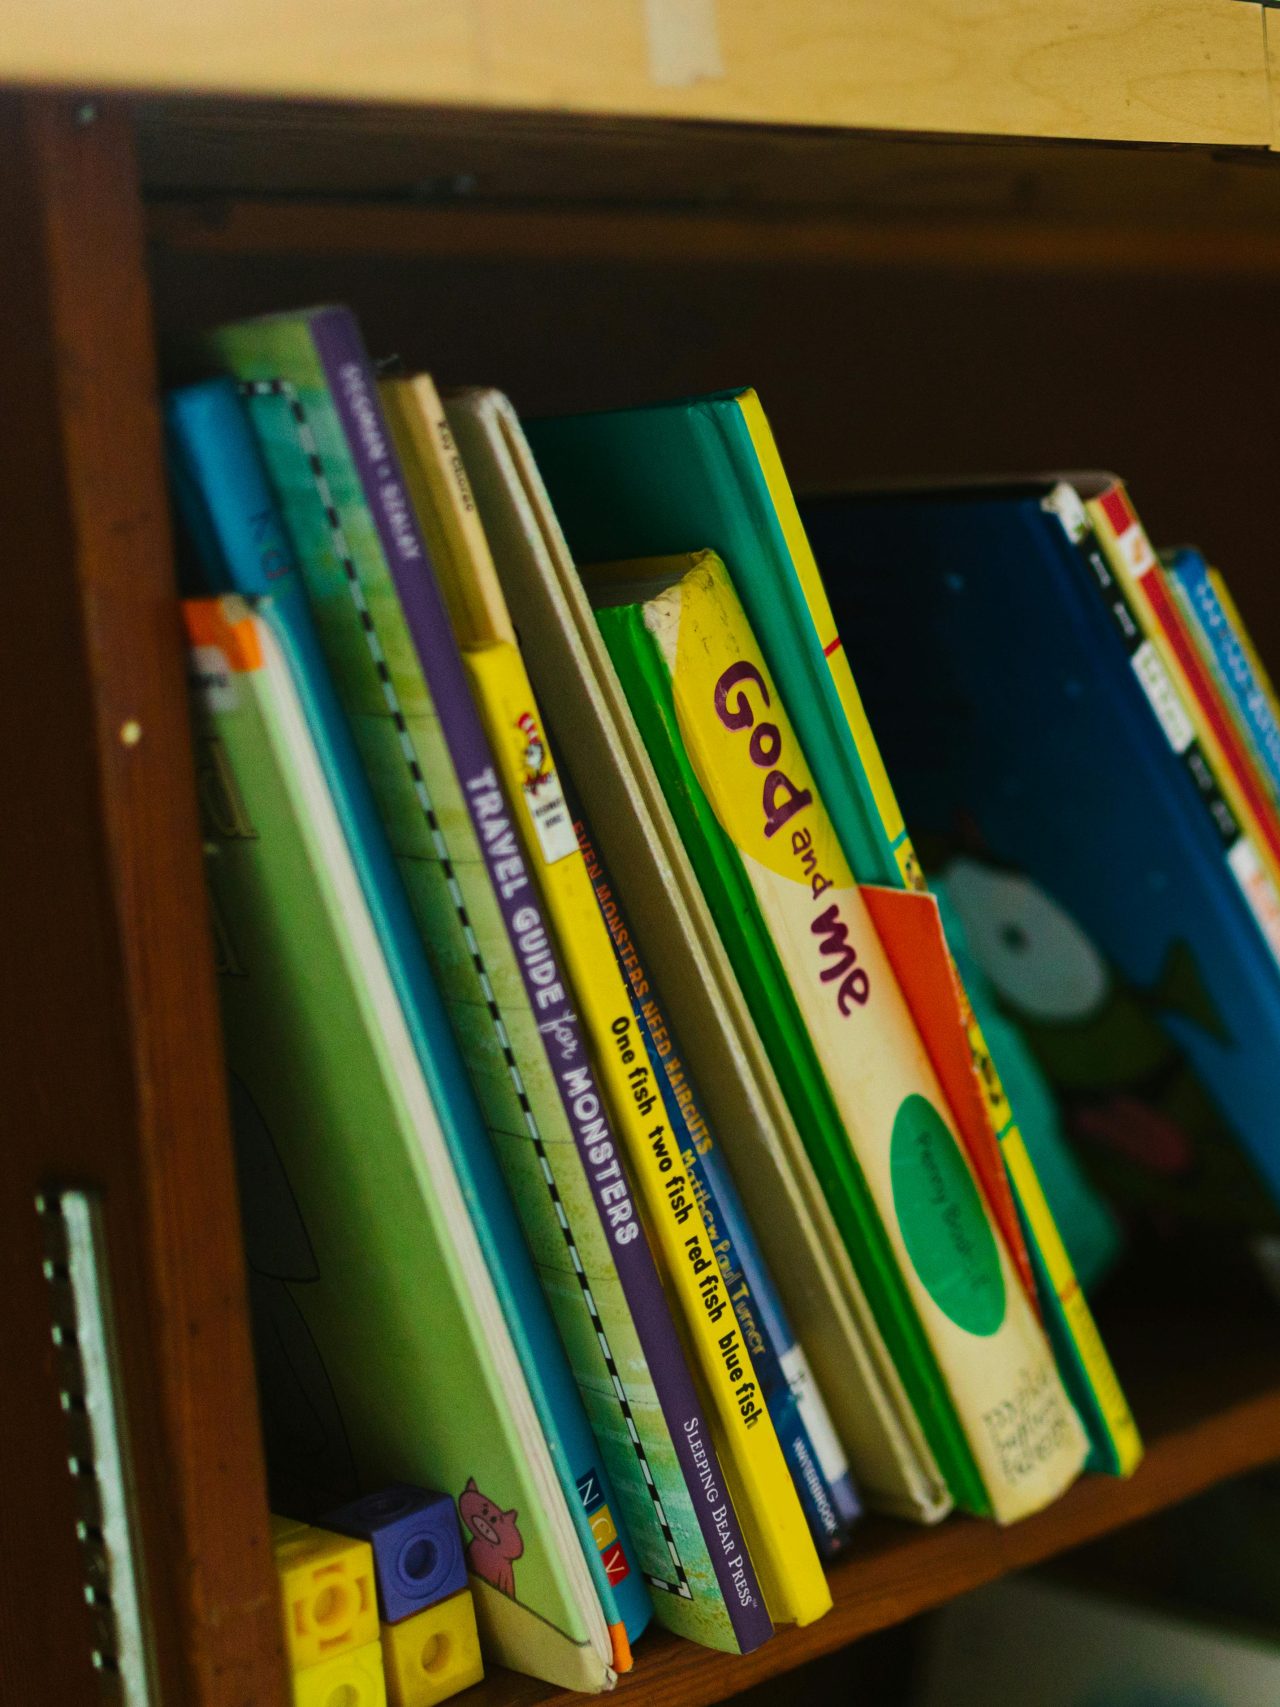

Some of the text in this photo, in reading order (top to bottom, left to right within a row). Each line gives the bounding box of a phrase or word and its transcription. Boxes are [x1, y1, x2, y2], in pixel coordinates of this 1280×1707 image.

[573, 819, 603, 880] EVEN
[596, 884, 650, 999] MONSTERS
[641, 1000, 672, 1057] NEED
[713, 660, 871, 1017] God and me
[466, 767, 529, 899] TRAVEL
[512, 907, 567, 1010] GUIDE
[540, 1010, 580, 1061] for
[562, 1066, 639, 1246] MONSTERS
[611, 1015, 636, 1065] One
[627, 1066, 658, 1117] fish
[648, 1125, 673, 1172] two
[665, 1174, 694, 1225] fish
[684, 1235, 713, 1275] red
[699, 1274, 727, 1324] fish
[718, 1329, 744, 1383] blue
[736, 1381, 767, 1431] fish
[714, 1239, 743, 1286] Paul
[731, 1282, 766, 1355] Turner
[684, 1417, 719, 1503] SLEEPING
[712, 1504, 735, 1555] BEAR
